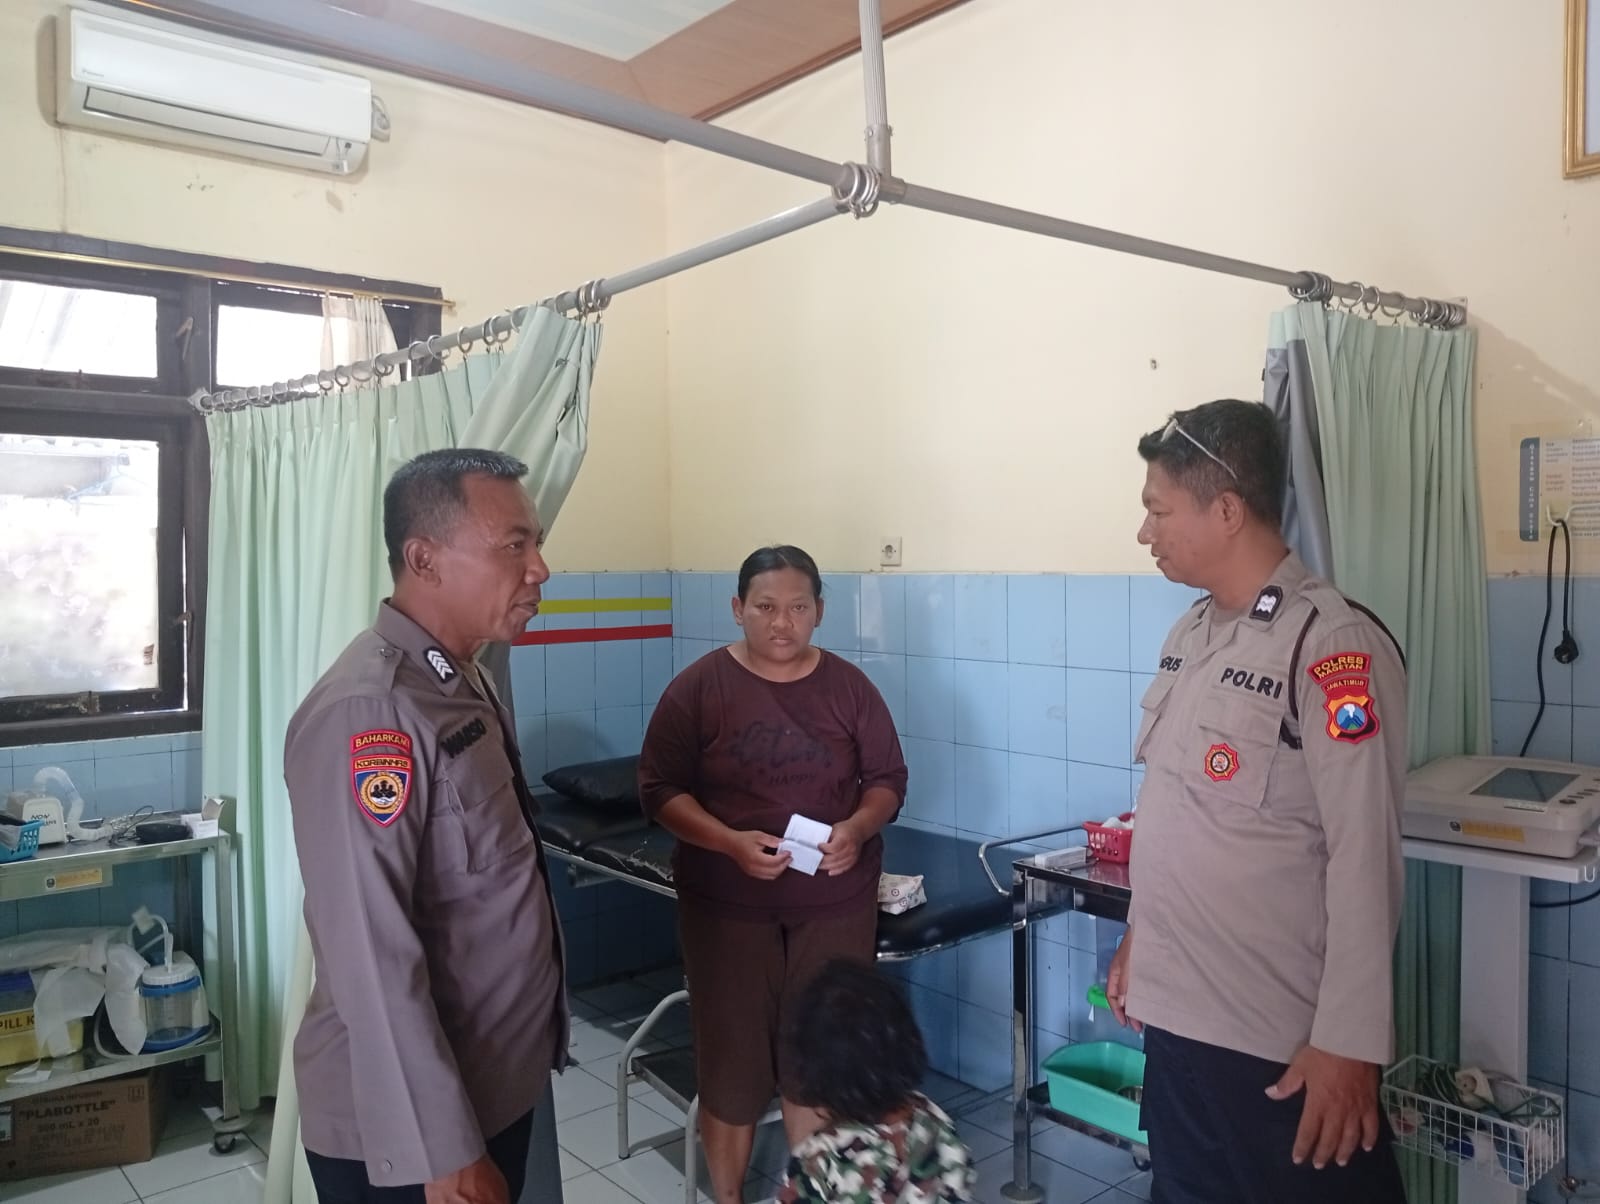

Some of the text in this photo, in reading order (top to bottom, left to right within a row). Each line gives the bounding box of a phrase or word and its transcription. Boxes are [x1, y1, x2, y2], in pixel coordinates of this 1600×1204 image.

[1313, 655, 1364, 675] POLRES
[1318, 663, 1363, 679] MAGETAN
[1220, 667, 1283, 699] POLRI
[768, 773, 817, 785] HAPPY
